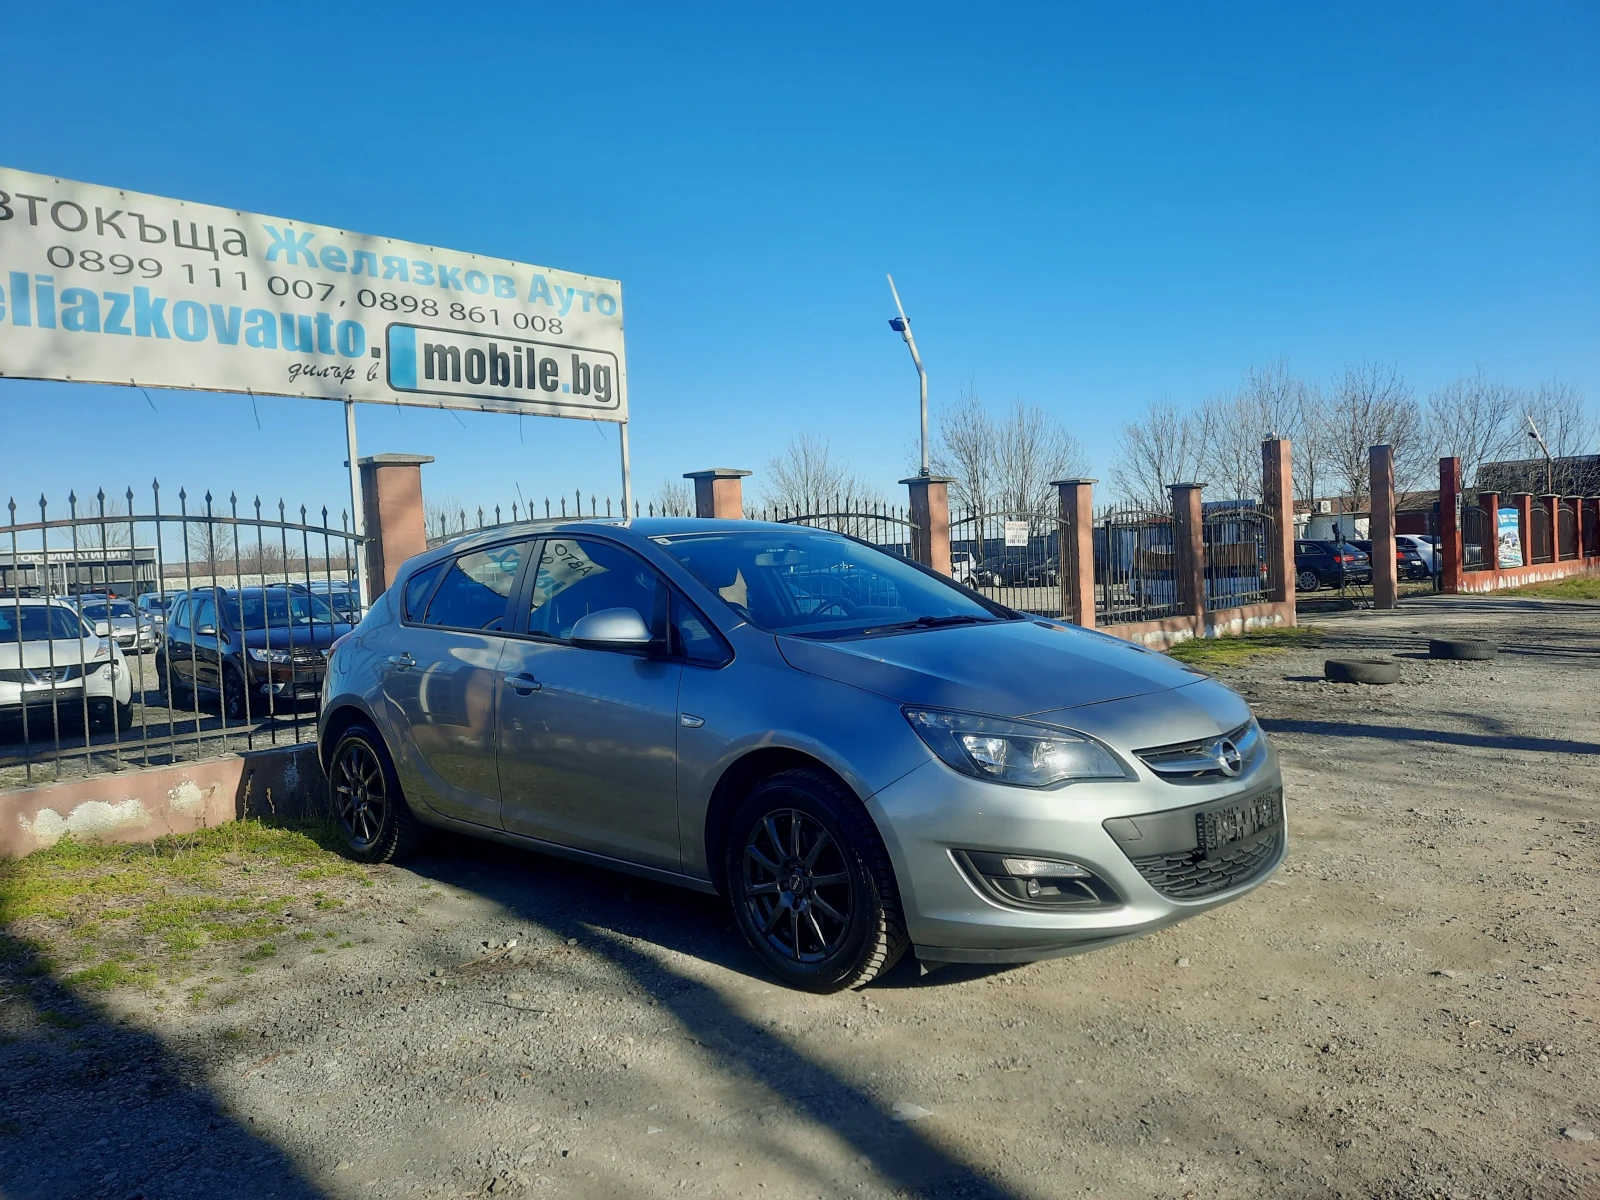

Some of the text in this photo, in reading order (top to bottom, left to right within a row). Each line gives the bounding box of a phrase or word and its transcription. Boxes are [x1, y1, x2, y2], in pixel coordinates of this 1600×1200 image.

[47, 245, 563, 335] 0899 111 007, 0898 861 008
[261, 224, 517, 299] Желязков
[528, 273, 617, 317] Ауто
[0, 271, 611, 403] liazkovauto. mobile.bg
[288, 363, 356, 385] дилър
